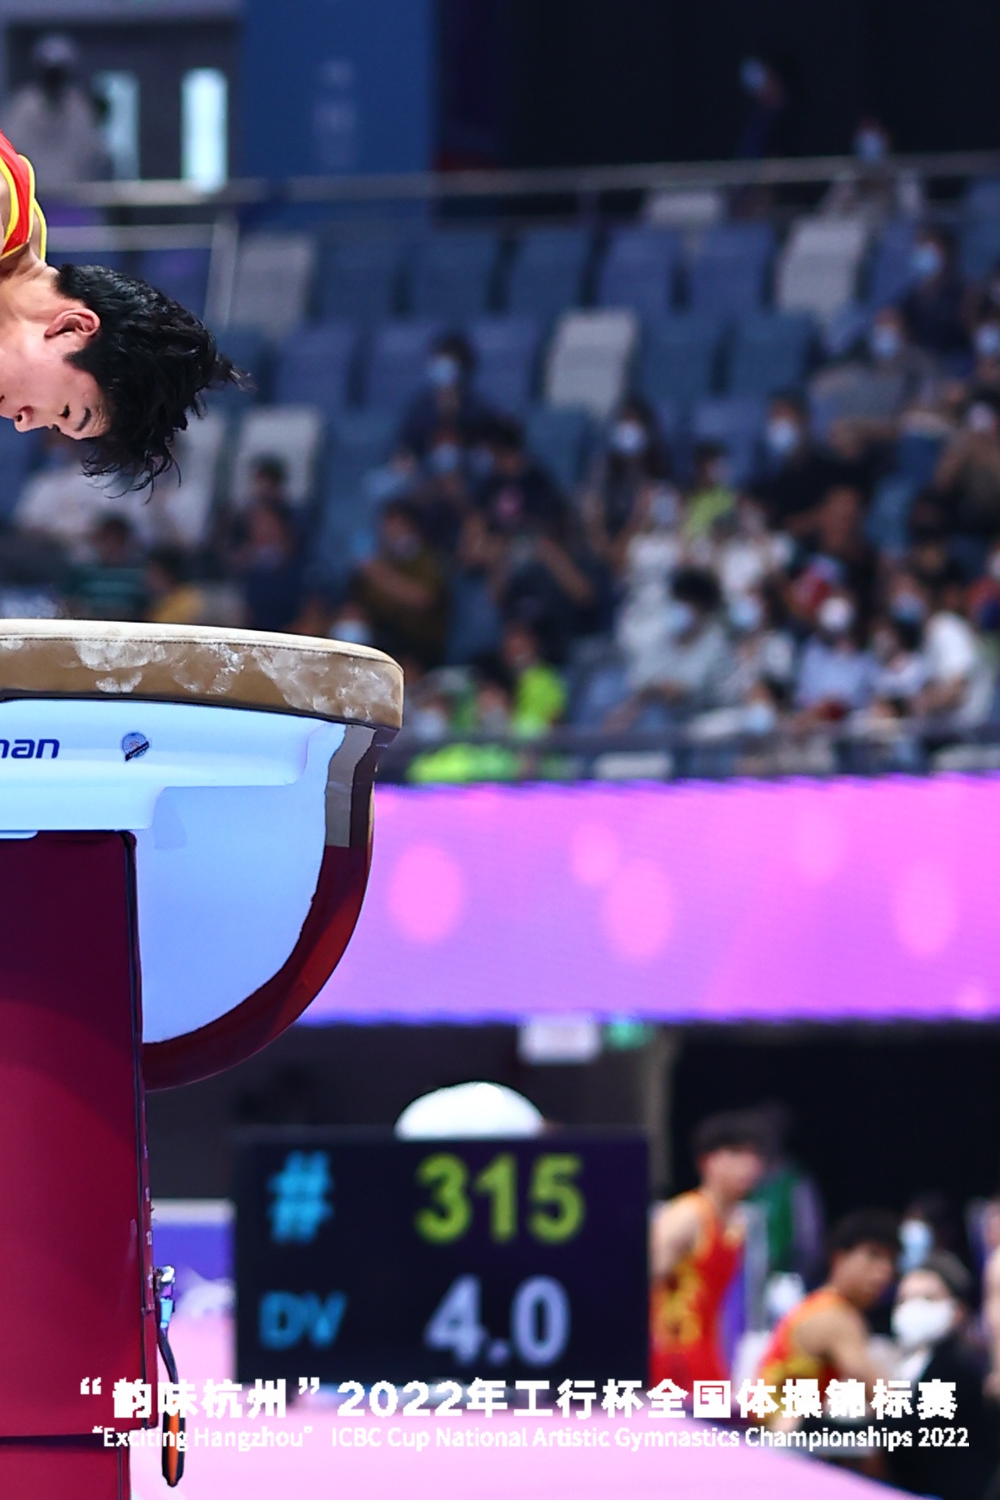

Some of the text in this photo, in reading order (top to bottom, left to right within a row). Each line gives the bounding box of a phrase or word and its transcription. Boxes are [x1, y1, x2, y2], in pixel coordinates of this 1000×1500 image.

[415, 1152, 584, 1244] 315
[258, 1274, 571, 1366] DV 4.0
